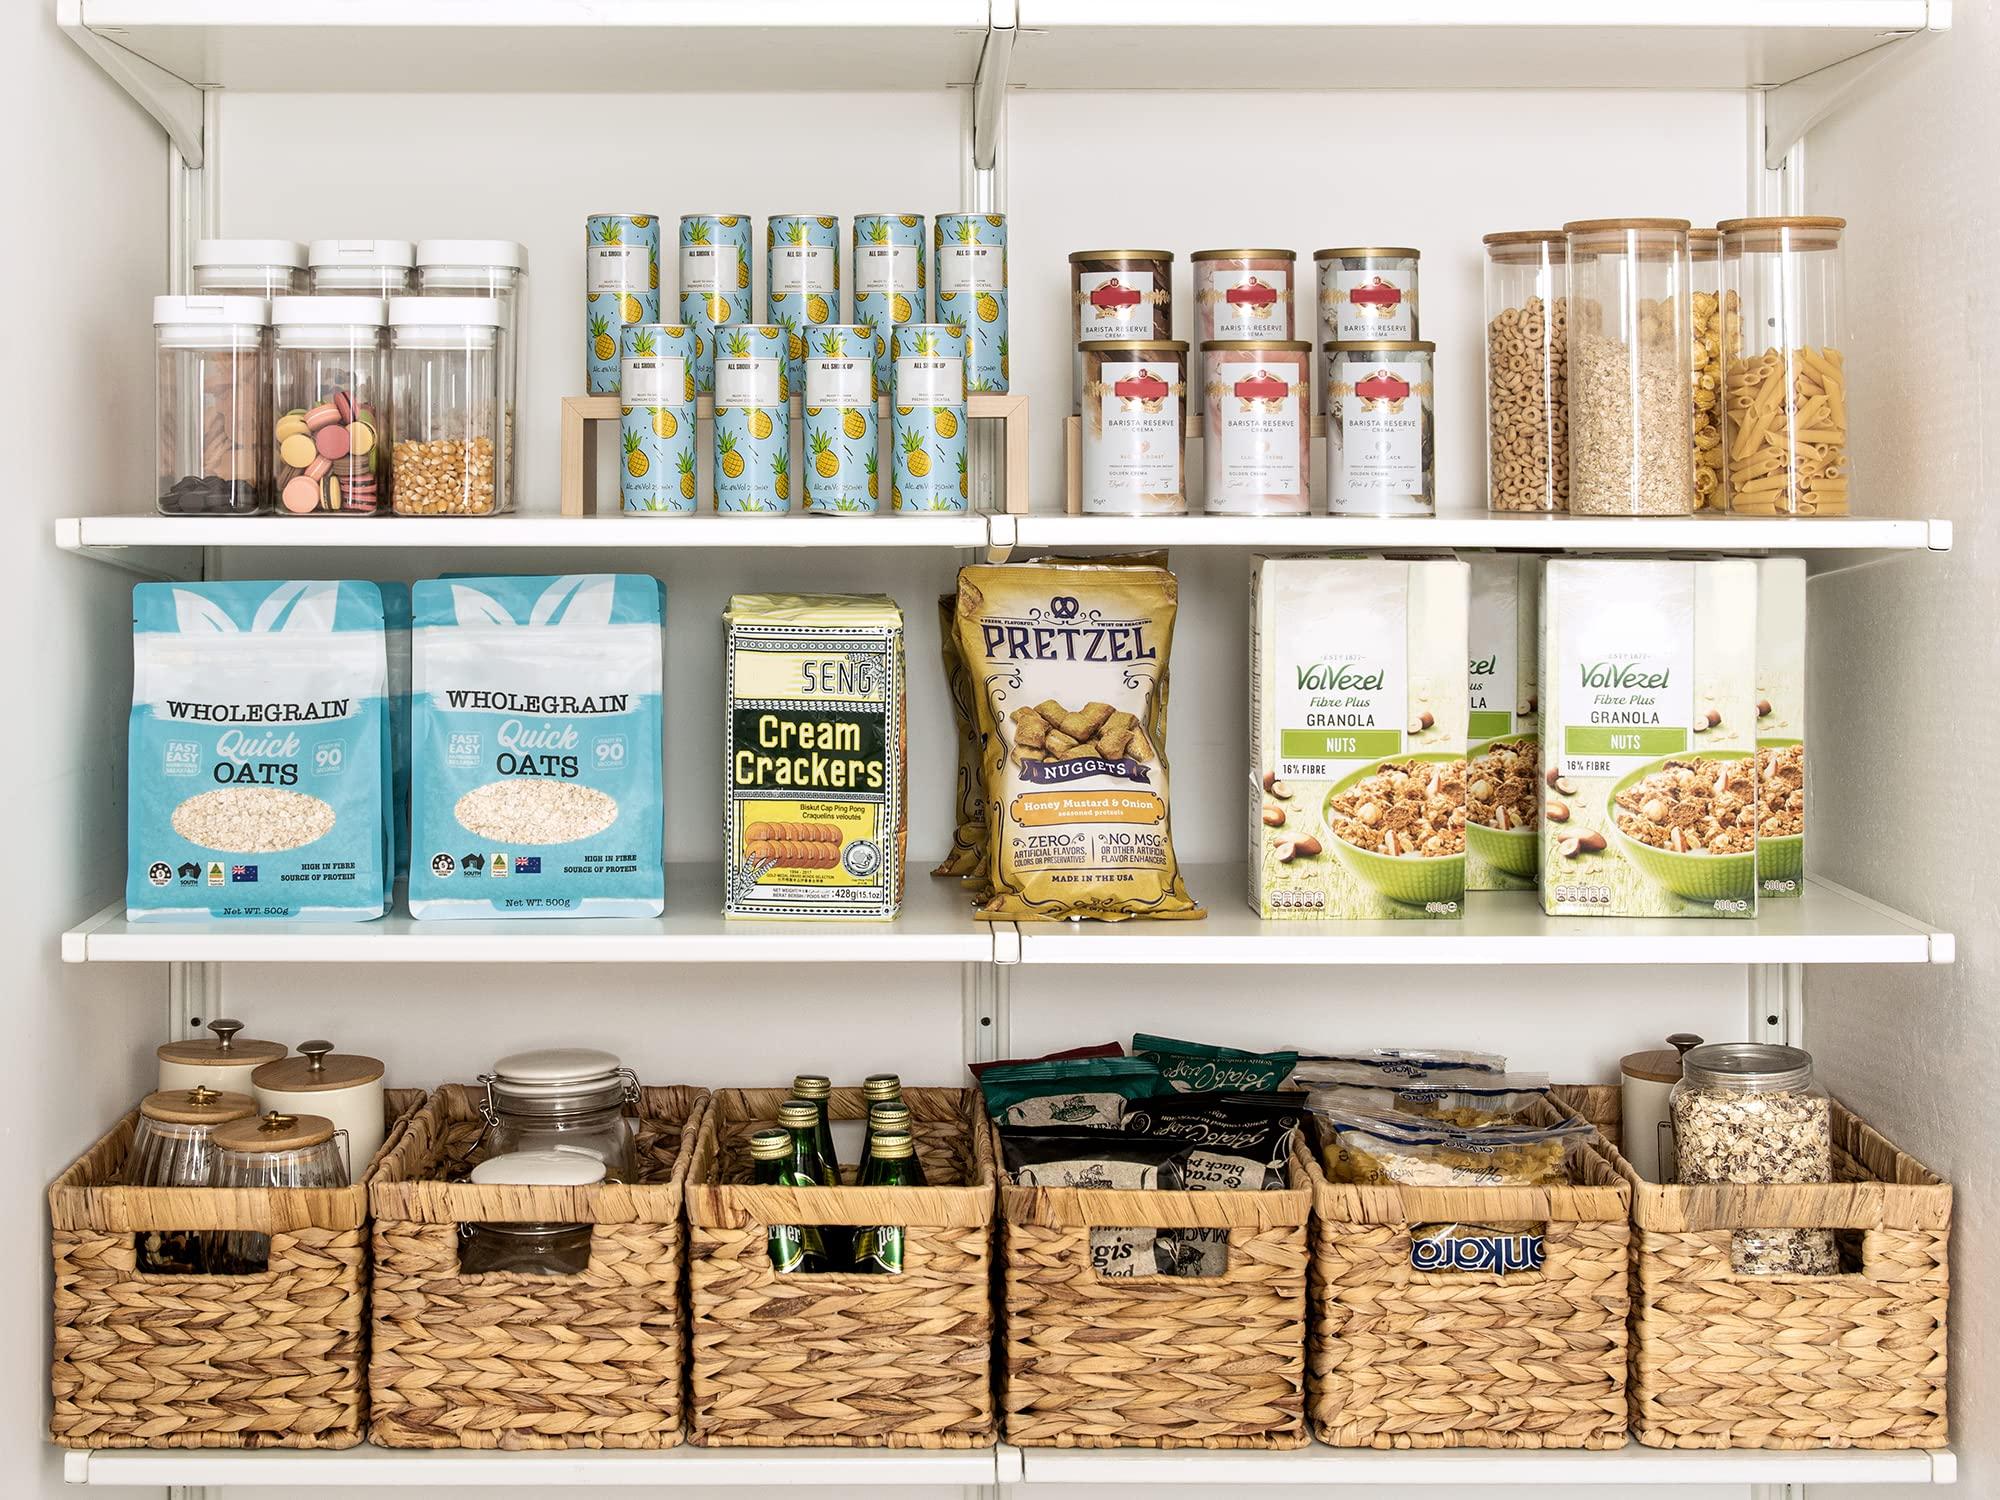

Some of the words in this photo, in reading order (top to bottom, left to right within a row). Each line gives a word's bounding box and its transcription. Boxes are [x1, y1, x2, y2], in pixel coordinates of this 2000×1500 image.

[981, 624, 1156, 662] PRETZEL
[802, 660, 873, 696] SENG
[1296, 664, 1385, 691] VolVezel
[1580, 662, 1670, 690] VolVezel
[446, 690, 629, 714] WHOLEGRAIN
[1310, 696, 1343, 708] Fibre
[1345, 696, 1370, 708] Plus
[1593, 694, 1627, 706] Fibre
[1629, 694, 1656, 706] Plus
[166, 698, 351, 722] WHOLEGRAIN
[1306, 714, 1375, 727] GRANOLA
[1590, 711, 1660, 724] GRANOLA
[497, 719, 579, 756] Quick
[759, 714, 860, 751] Cream
[451, 734, 480, 744] FAST
[1326, 737, 1356, 753] NUTS
[1610, 735, 1641, 750] NUTS
[169, 742, 198, 754] FAST
[216, 729, 300, 766] Quick
[449, 744, 481, 754] EASY
[596, 743, 624, 761] 90
[166, 752, 200, 763] EASY
[316, 749, 342, 767] 90
[496, 752, 579, 778] OATS
[735, 750, 884, 788] Crackers
[1044, 760, 1127, 780] NUGGETS
[1283, 764, 1300, 774] 16%
[1302, 764, 1326, 774] FIBRE
[1567, 761, 1584, 771] 16%
[1586, 761, 1611, 771] FIBRE
[214, 762, 299, 786] OATS
[800, 804, 820, 812] Biskut
[820, 804, 834, 812] Cap
[834, 805, 848, 814] Ping
[849, 806, 866, 814] Pong
[1024, 802, 1060, 811] Honey
[1063, 800, 1108, 809] Mustard
[1111, 800, 1120, 808] &
[1122, 801, 1154, 810] Onion
[802, 812, 835, 820] Craquelins
[1094, 809, 1124, 817] pretzels
[1028, 835, 1071, 849] ZERO
[1109, 834, 1130, 846] NO
[1134, 834, 1161, 846] MSG
[1014, 848, 1051, 859] ARTIFICIAL
[1053, 847, 1087, 857] FLAVORS,
[1112, 847, 1135, 855] OTHER
[1137, 847, 1166, 857] ARTIFICIAL
[584, 855, 604, 863] HIGH
[615, 854, 637, 862] FIBRE
[1014, 859, 1034, 868] COLORS
[1044, 856, 1086, 864] PRESERVATIVES
[1101, 855, 1128, 863] FLAVOR
[1129, 855, 1167, 865] ENHANCERS
[301, 863, 320, 871] HIGH
[332, 862, 356, 870] FIBRE
[606, 865, 638, 873] PROTEIN
[280, 874, 310, 882] SOURCE
[323, 873, 356, 881] PROTEIN
[1051, 875, 1080, 883] MADE
[1081, 875, 1092, 883] IN
[1094, 874, 1115, 883] THE
[1116, 874, 1134, 882] USA
[505, 899, 524, 907] Net
[525, 899, 543, 907] WT.
[545, 899, 570, 908] 500g
[224, 907, 242, 915] Net
[244, 907, 261, 915] WT.
[264, 907, 289, 916] 500g
[1214, 1161, 1245, 1175] black
[1223, 1176, 1242, 1189] &
